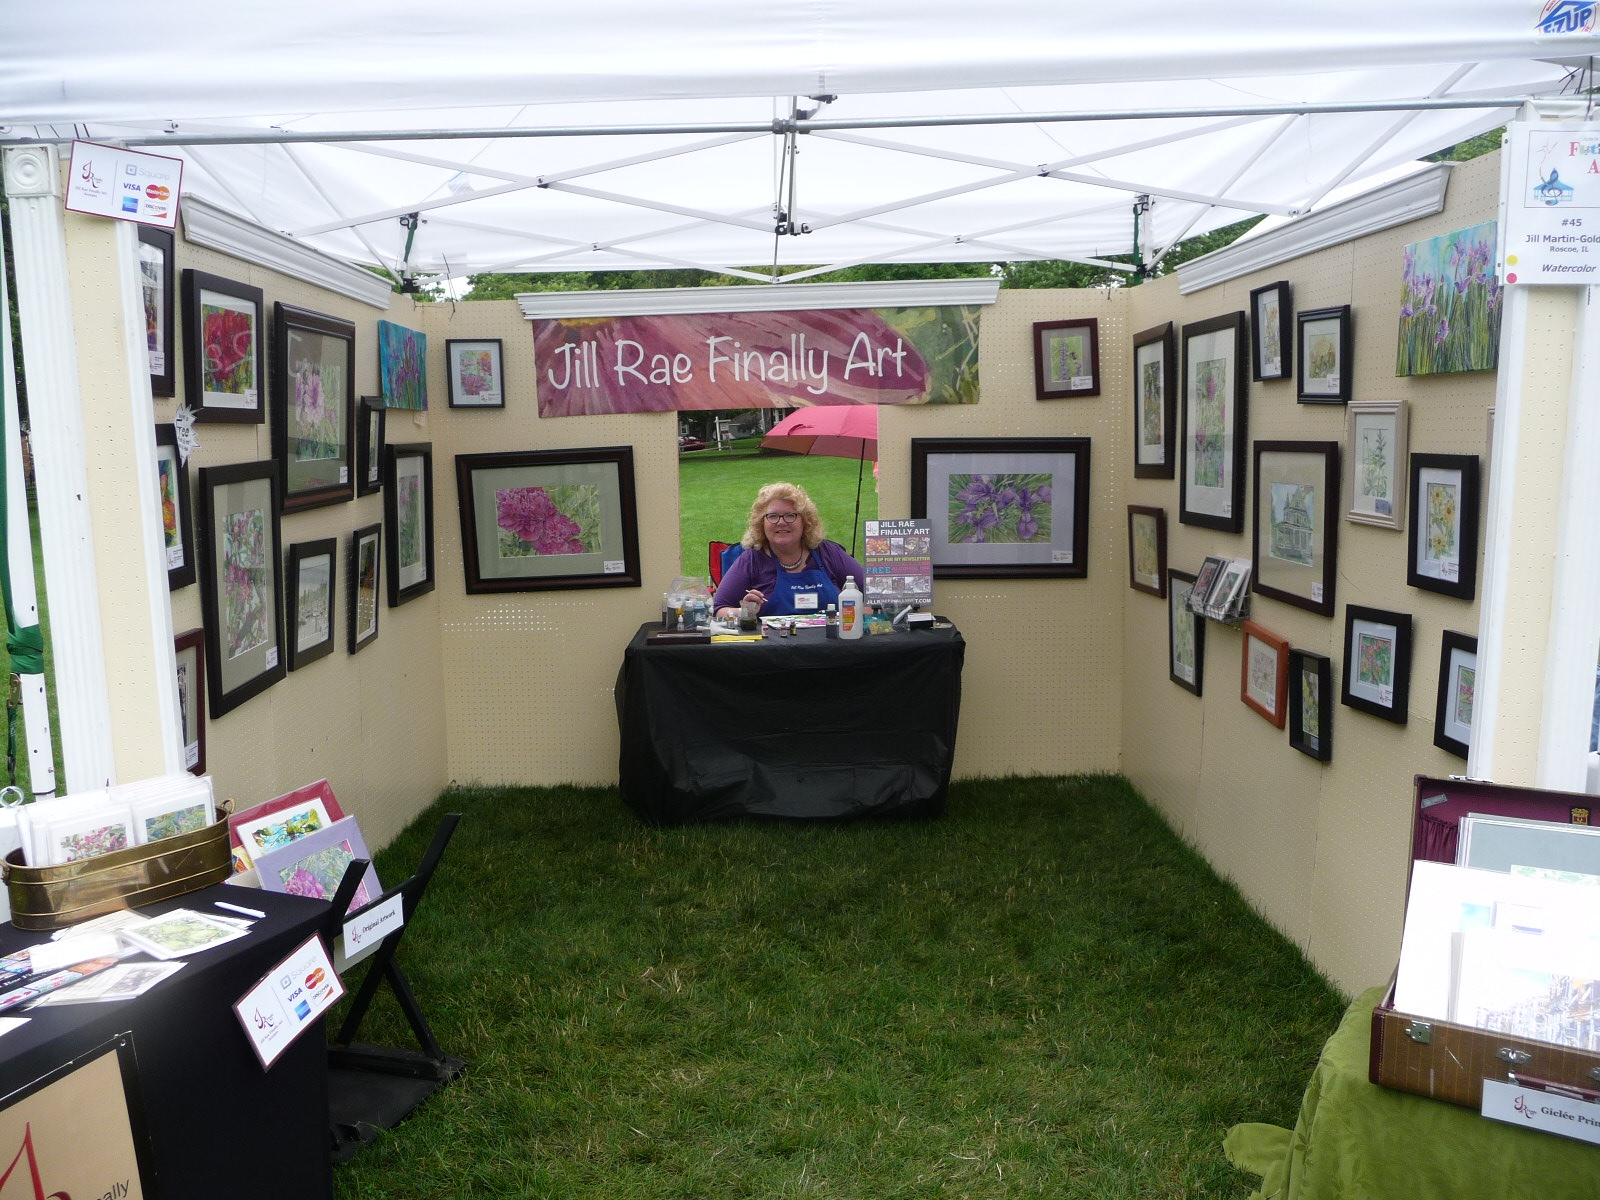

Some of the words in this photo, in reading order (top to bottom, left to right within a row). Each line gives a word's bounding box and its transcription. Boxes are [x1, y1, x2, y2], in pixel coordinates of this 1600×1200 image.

[138, 168, 170, 180] Square
[123, 182, 141, 192] VISA
[1561, 218, 1582, 227] #45
[1525, 235, 1540, 243] Jill
[1541, 264, 1597, 273] Watercolor
[548, 340, 600, 390] Jill
[613, 338, 693, 387] Rae
[705, 332, 829, 394] Finally
[843, 331, 907, 381] Art
[866, 566, 891, 574] FREE
[362, 917, 381, 934] Original
[379, 909, 396, 925] Artwork
[288, 987, 303, 1002] VISA
[1541, 1106, 1575, 1121] Giclée
